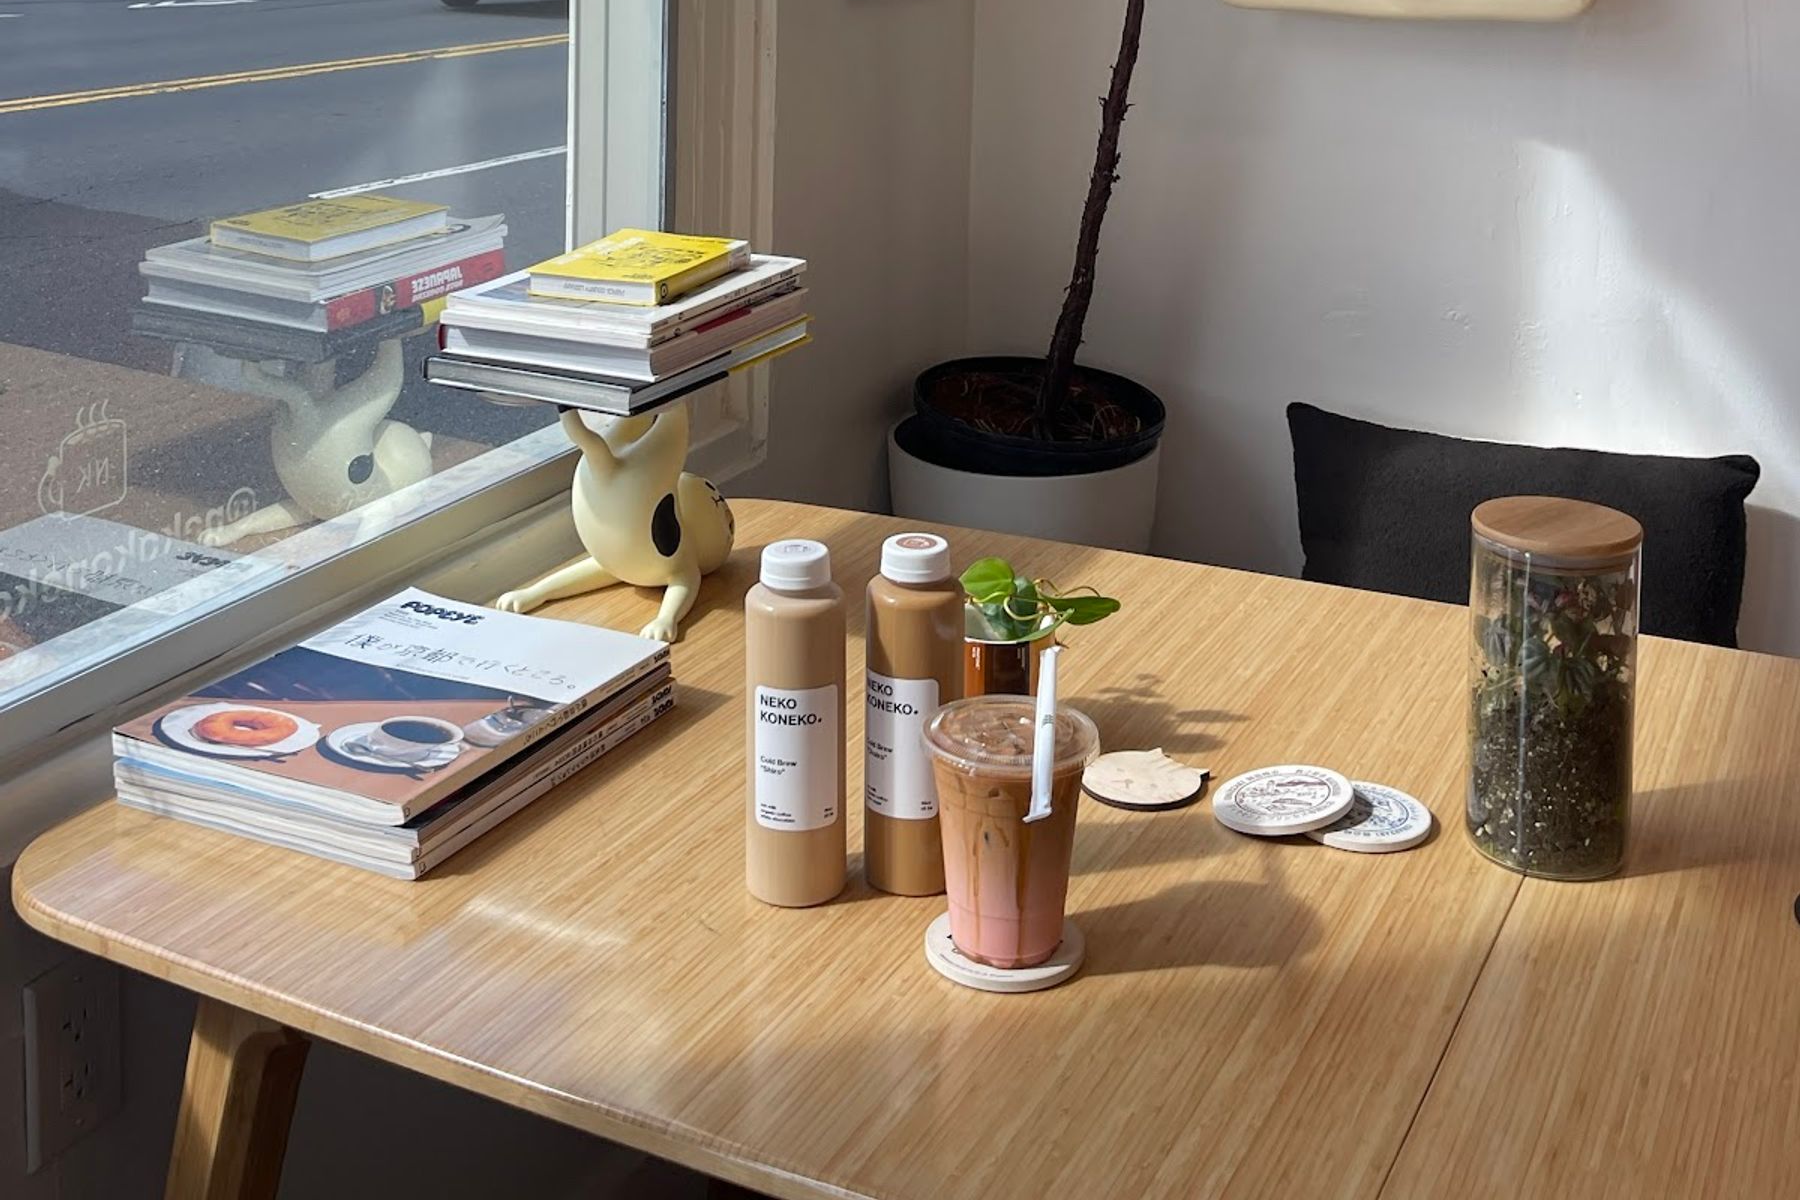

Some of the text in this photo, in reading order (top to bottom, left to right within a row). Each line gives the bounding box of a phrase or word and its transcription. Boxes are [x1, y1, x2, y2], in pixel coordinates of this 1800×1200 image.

[400, 601, 485, 625] POPEYE
[760, 694, 797, 710] NEKO
[777, 759, 798, 768] Brew
